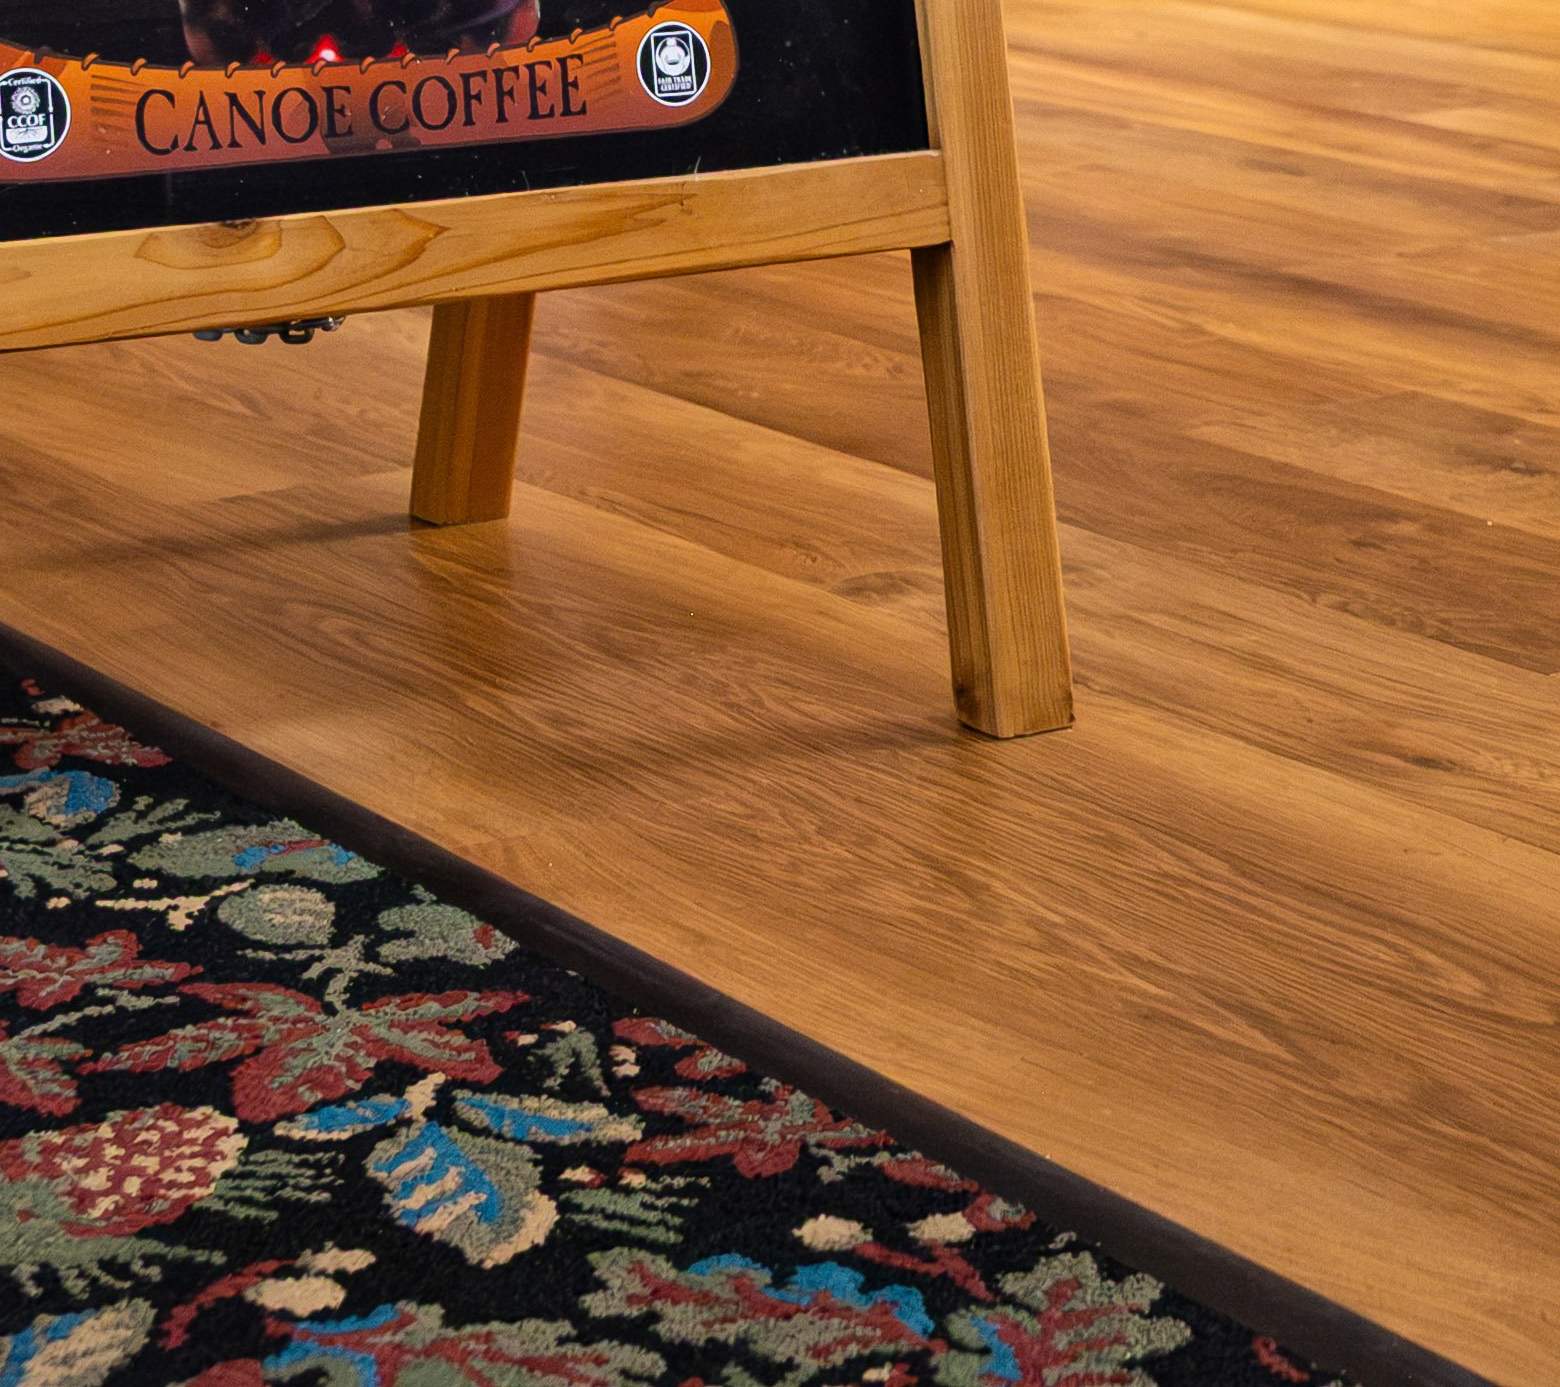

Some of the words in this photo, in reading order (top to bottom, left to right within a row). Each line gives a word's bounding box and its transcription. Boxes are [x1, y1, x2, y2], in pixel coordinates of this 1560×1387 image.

[7, 113, 46, 128] CCOF
[134, 84, 354, 157] CANOE
[368, 53, 589, 136] COFFEE
